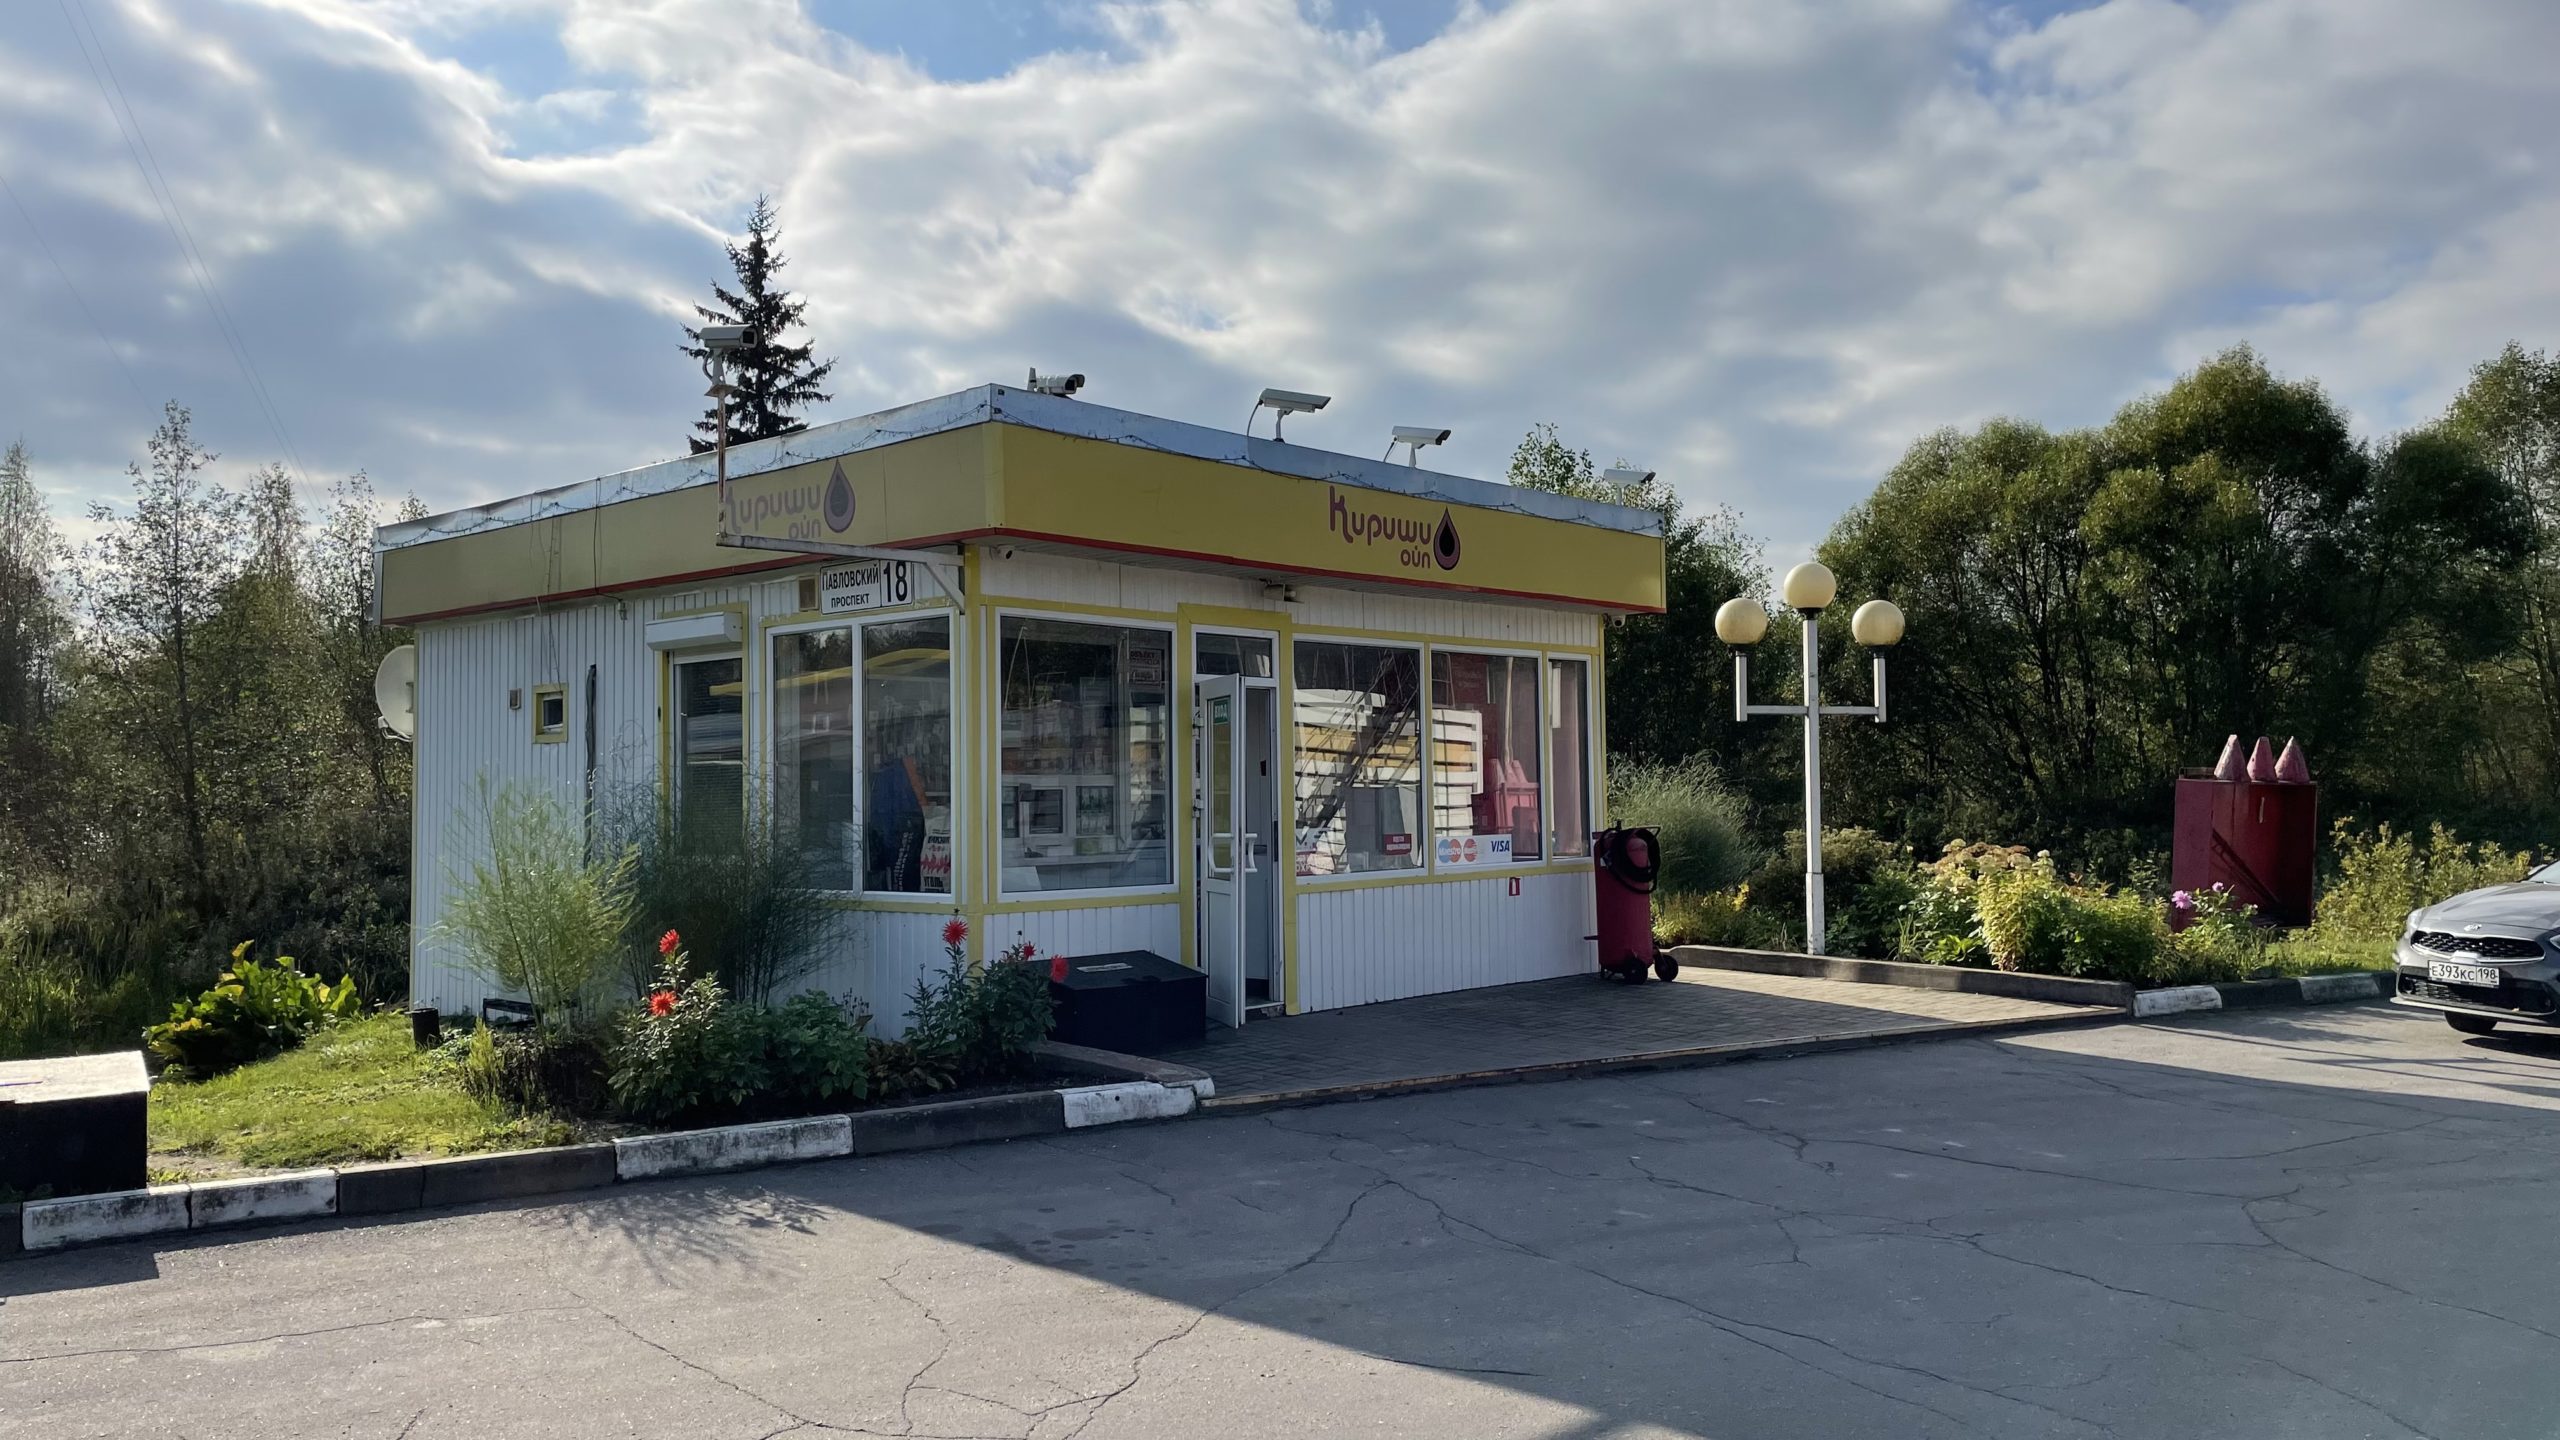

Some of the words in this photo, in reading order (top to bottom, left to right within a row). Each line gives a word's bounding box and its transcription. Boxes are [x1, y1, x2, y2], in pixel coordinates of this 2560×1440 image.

[788, 515, 821, 539] ойл
[1329, 485, 1431, 546] Кириши
[1400, 545, 1431, 569] ойл
[822, 563, 879, 591] ПАВЛОВСКИЙ
[883, 561, 908, 603] 18
[831, 593, 870, 609] ПРОСПЕКТ
[1491, 840, 1510, 853] VISA
[2477, 968, 2496, 980] 198
